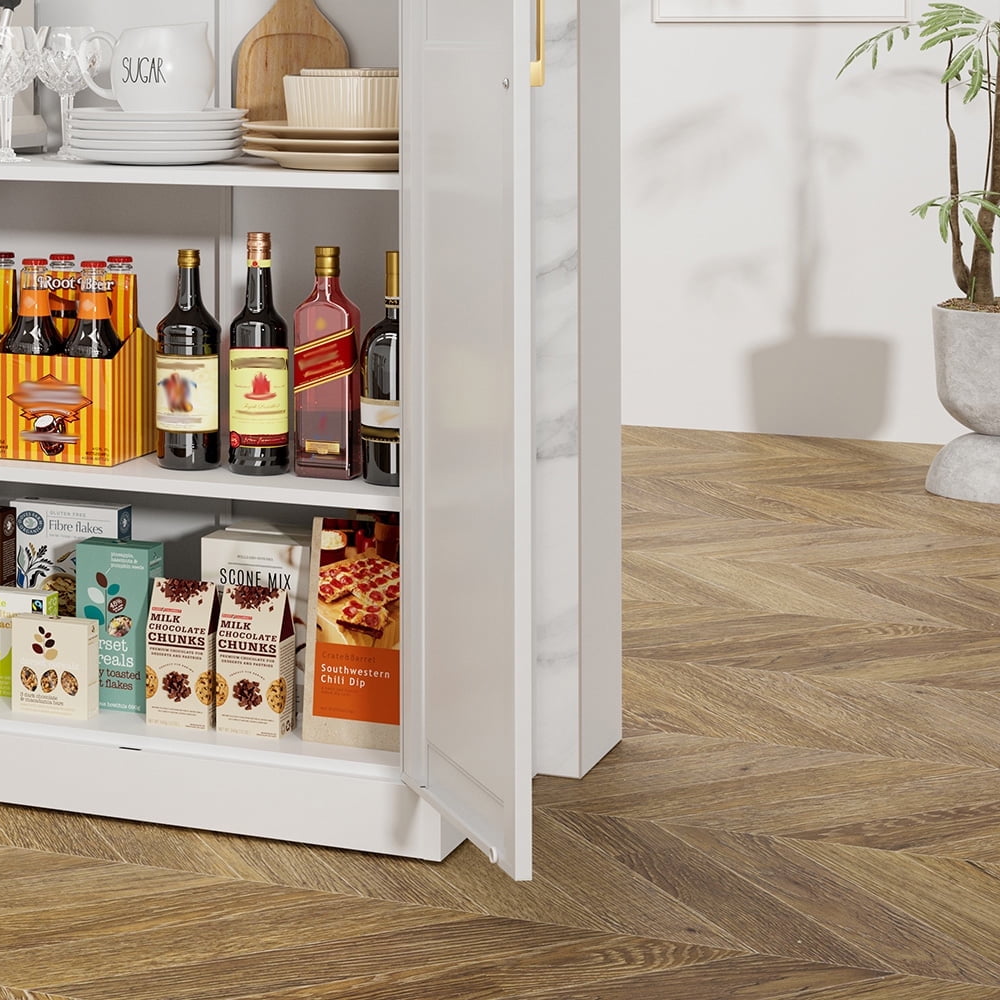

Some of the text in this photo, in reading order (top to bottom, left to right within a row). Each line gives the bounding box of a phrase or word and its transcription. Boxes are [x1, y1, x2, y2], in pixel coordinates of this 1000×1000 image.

[122, 56, 166, 83] SUGAR
[38, 275, 77, 290] Root
[49, 519, 104, 535] Fibre flakes
[219, 567, 291, 590] SCONE MIX
[150, 613, 181, 623] MILK
[220, 620, 252, 630] MILK
[148, 623, 206, 635] CHOCOLATE
[219, 630, 278, 642] CHOCOLATE
[148, 632, 205, 646] CHUNKS
[218, 639, 277, 654] CHUNKS
[106, 669, 141, 680] toasted
[321, 663, 390, 679] Southwestern
[105, 679, 133, 690] flakes
[320, 674, 366, 688] Chili Dip
